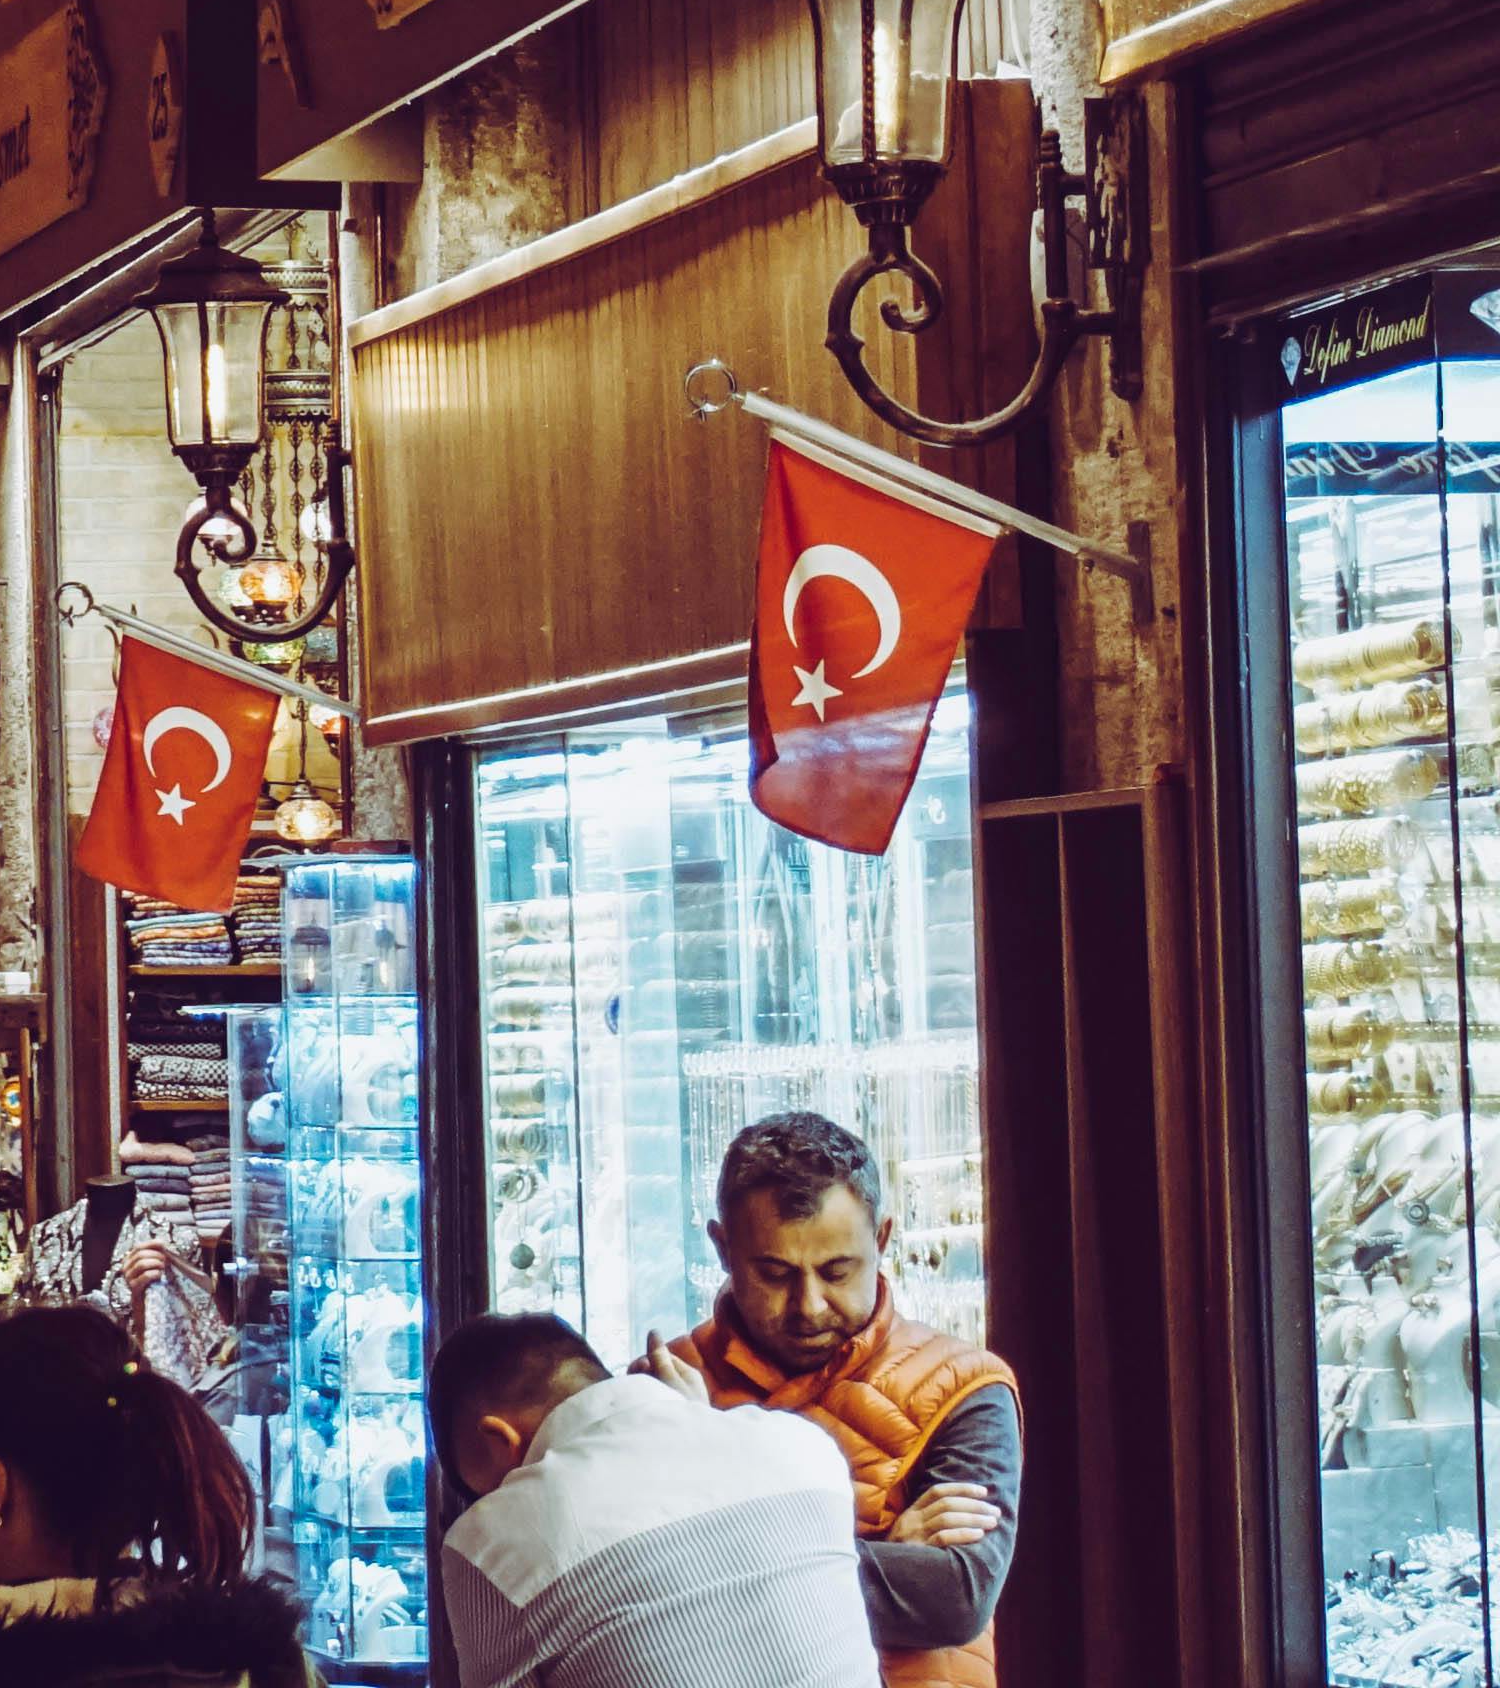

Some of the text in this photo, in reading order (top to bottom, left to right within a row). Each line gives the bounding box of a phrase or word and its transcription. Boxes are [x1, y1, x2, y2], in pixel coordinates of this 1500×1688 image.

[152, 71, 169, 142] 25
[1303, 293, 1431, 384] Define Diamond
